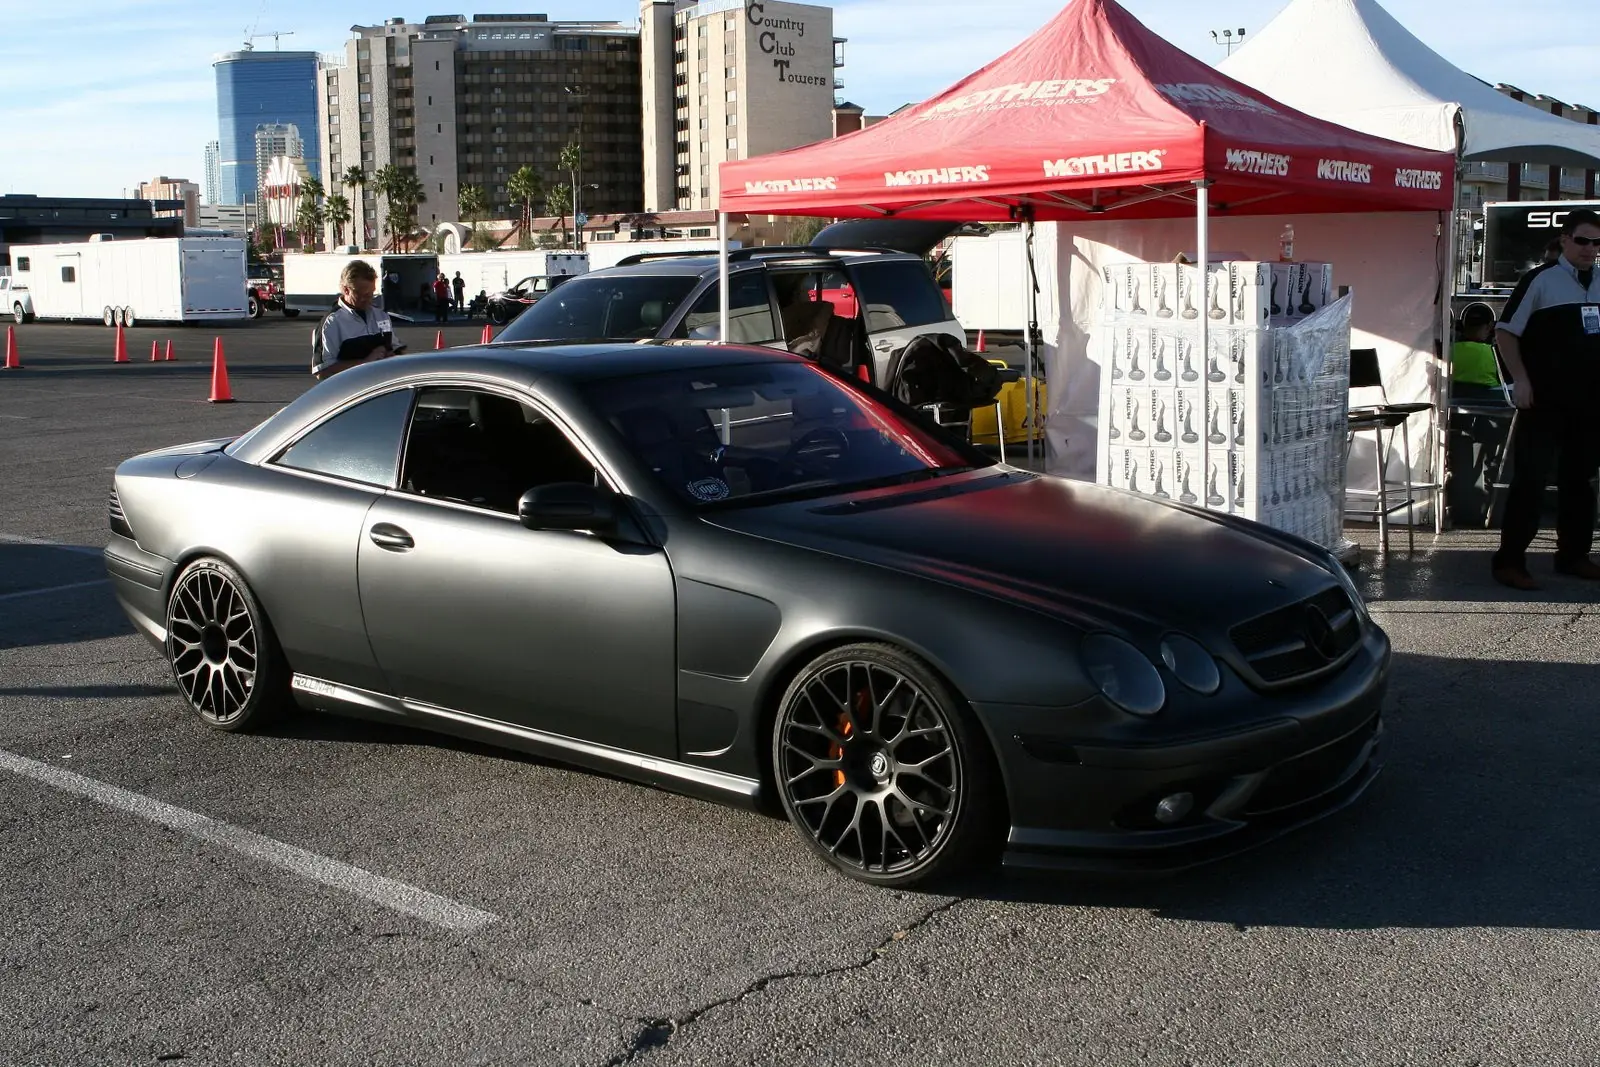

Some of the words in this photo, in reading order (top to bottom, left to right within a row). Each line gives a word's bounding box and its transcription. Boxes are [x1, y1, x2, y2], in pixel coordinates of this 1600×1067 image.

[747, 3, 804, 37] Country
[759, 31, 795, 56] Club
[774, 59, 826, 86] Towers
[1043, 150, 1162, 178] MOTHERS
[1225, 148, 1290, 176] MOTHERS
[1317, 158, 1372, 184] MOTHERS
[745, 177, 837, 193] MOTHERS
[884, 165, 990, 187] MOTHERS
[1395, 167, 1442, 190] MOTHERS
